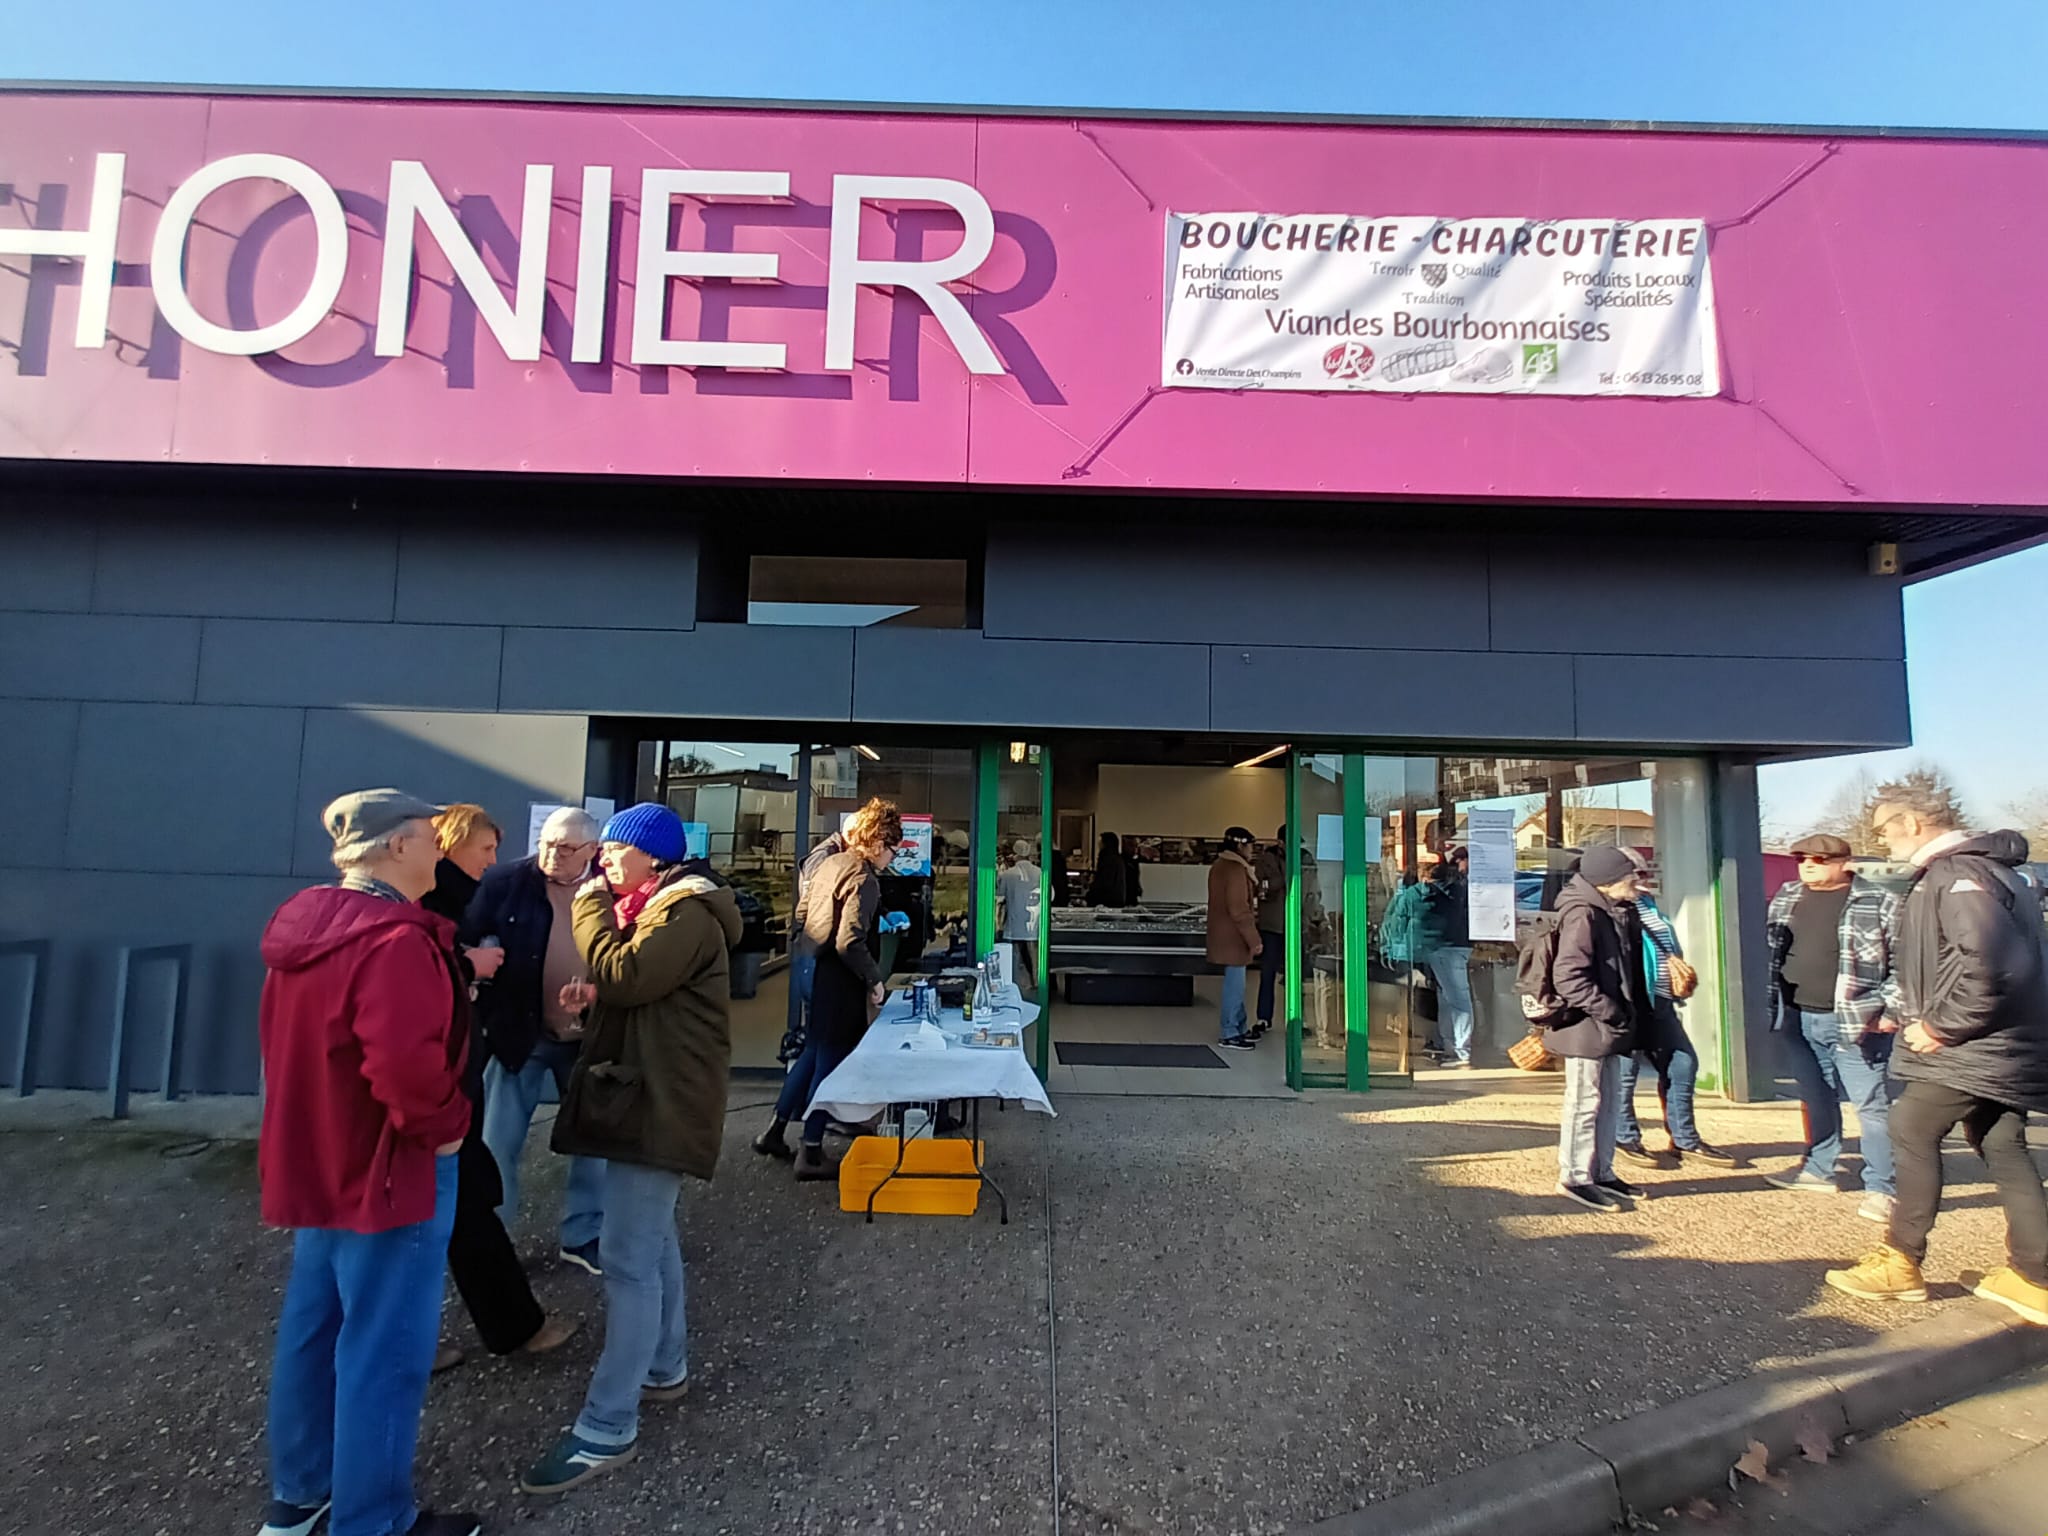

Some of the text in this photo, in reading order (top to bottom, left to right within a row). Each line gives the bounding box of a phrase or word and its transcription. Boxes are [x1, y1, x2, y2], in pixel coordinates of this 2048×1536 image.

[1180, 221, 1399, 252] BOUCHERIE
[1432, 226, 1698, 258] CHARCUTERIE
[1182, 262, 1283, 282] Fabrications
[1370, 261, 1414, 276] Terroir
[1452, 263, 1502, 279] Qualité
[1563, 271, 1696, 288] Produits Locaux
[1185, 282, 1280, 301] Artisanales
[1402, 290, 1465, 306] Tradition
[1584, 289, 1674, 311] Spécialités
[1265, 308, 1611, 341] Viandes Bourbonnaises
[1196, 367, 1217, 376] Vente
[1218, 367, 1245, 377] Directe
